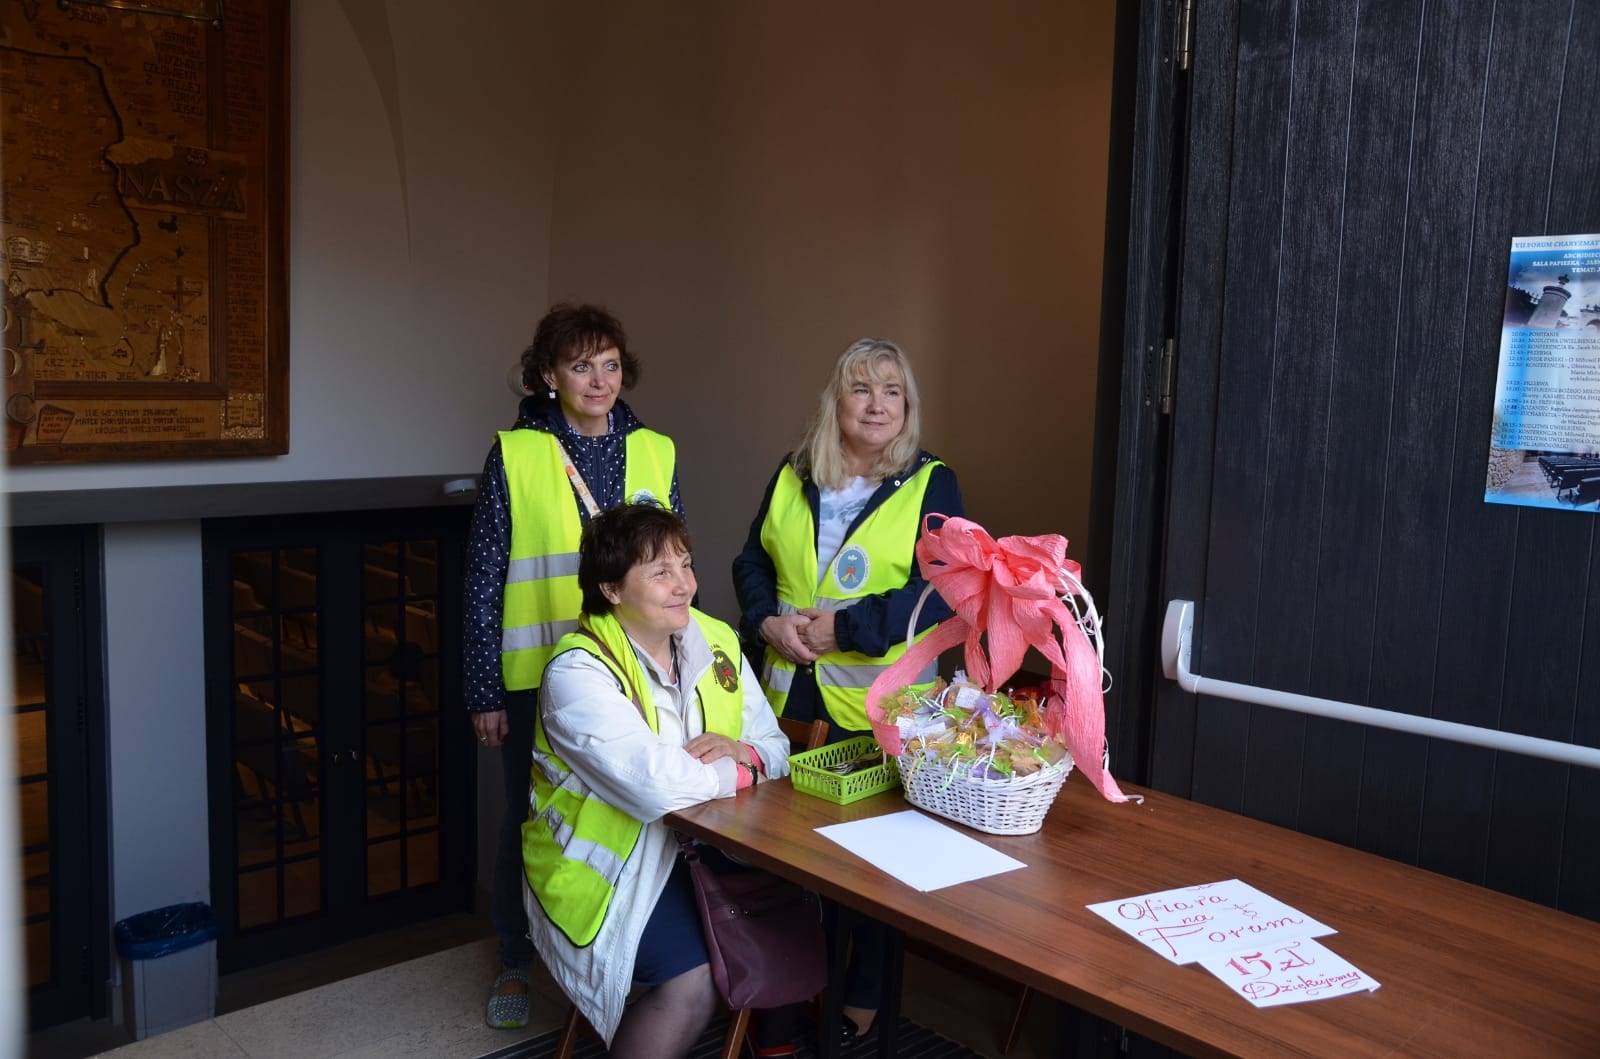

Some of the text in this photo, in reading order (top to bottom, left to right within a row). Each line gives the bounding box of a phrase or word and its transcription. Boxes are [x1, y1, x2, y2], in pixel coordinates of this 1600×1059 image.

[1117, 895, 1229, 922] Ofiara
[1182, 913, 1215, 925] na
[1137, 917, 1304, 957] Forum
[1225, 951, 1273, 981] 15
